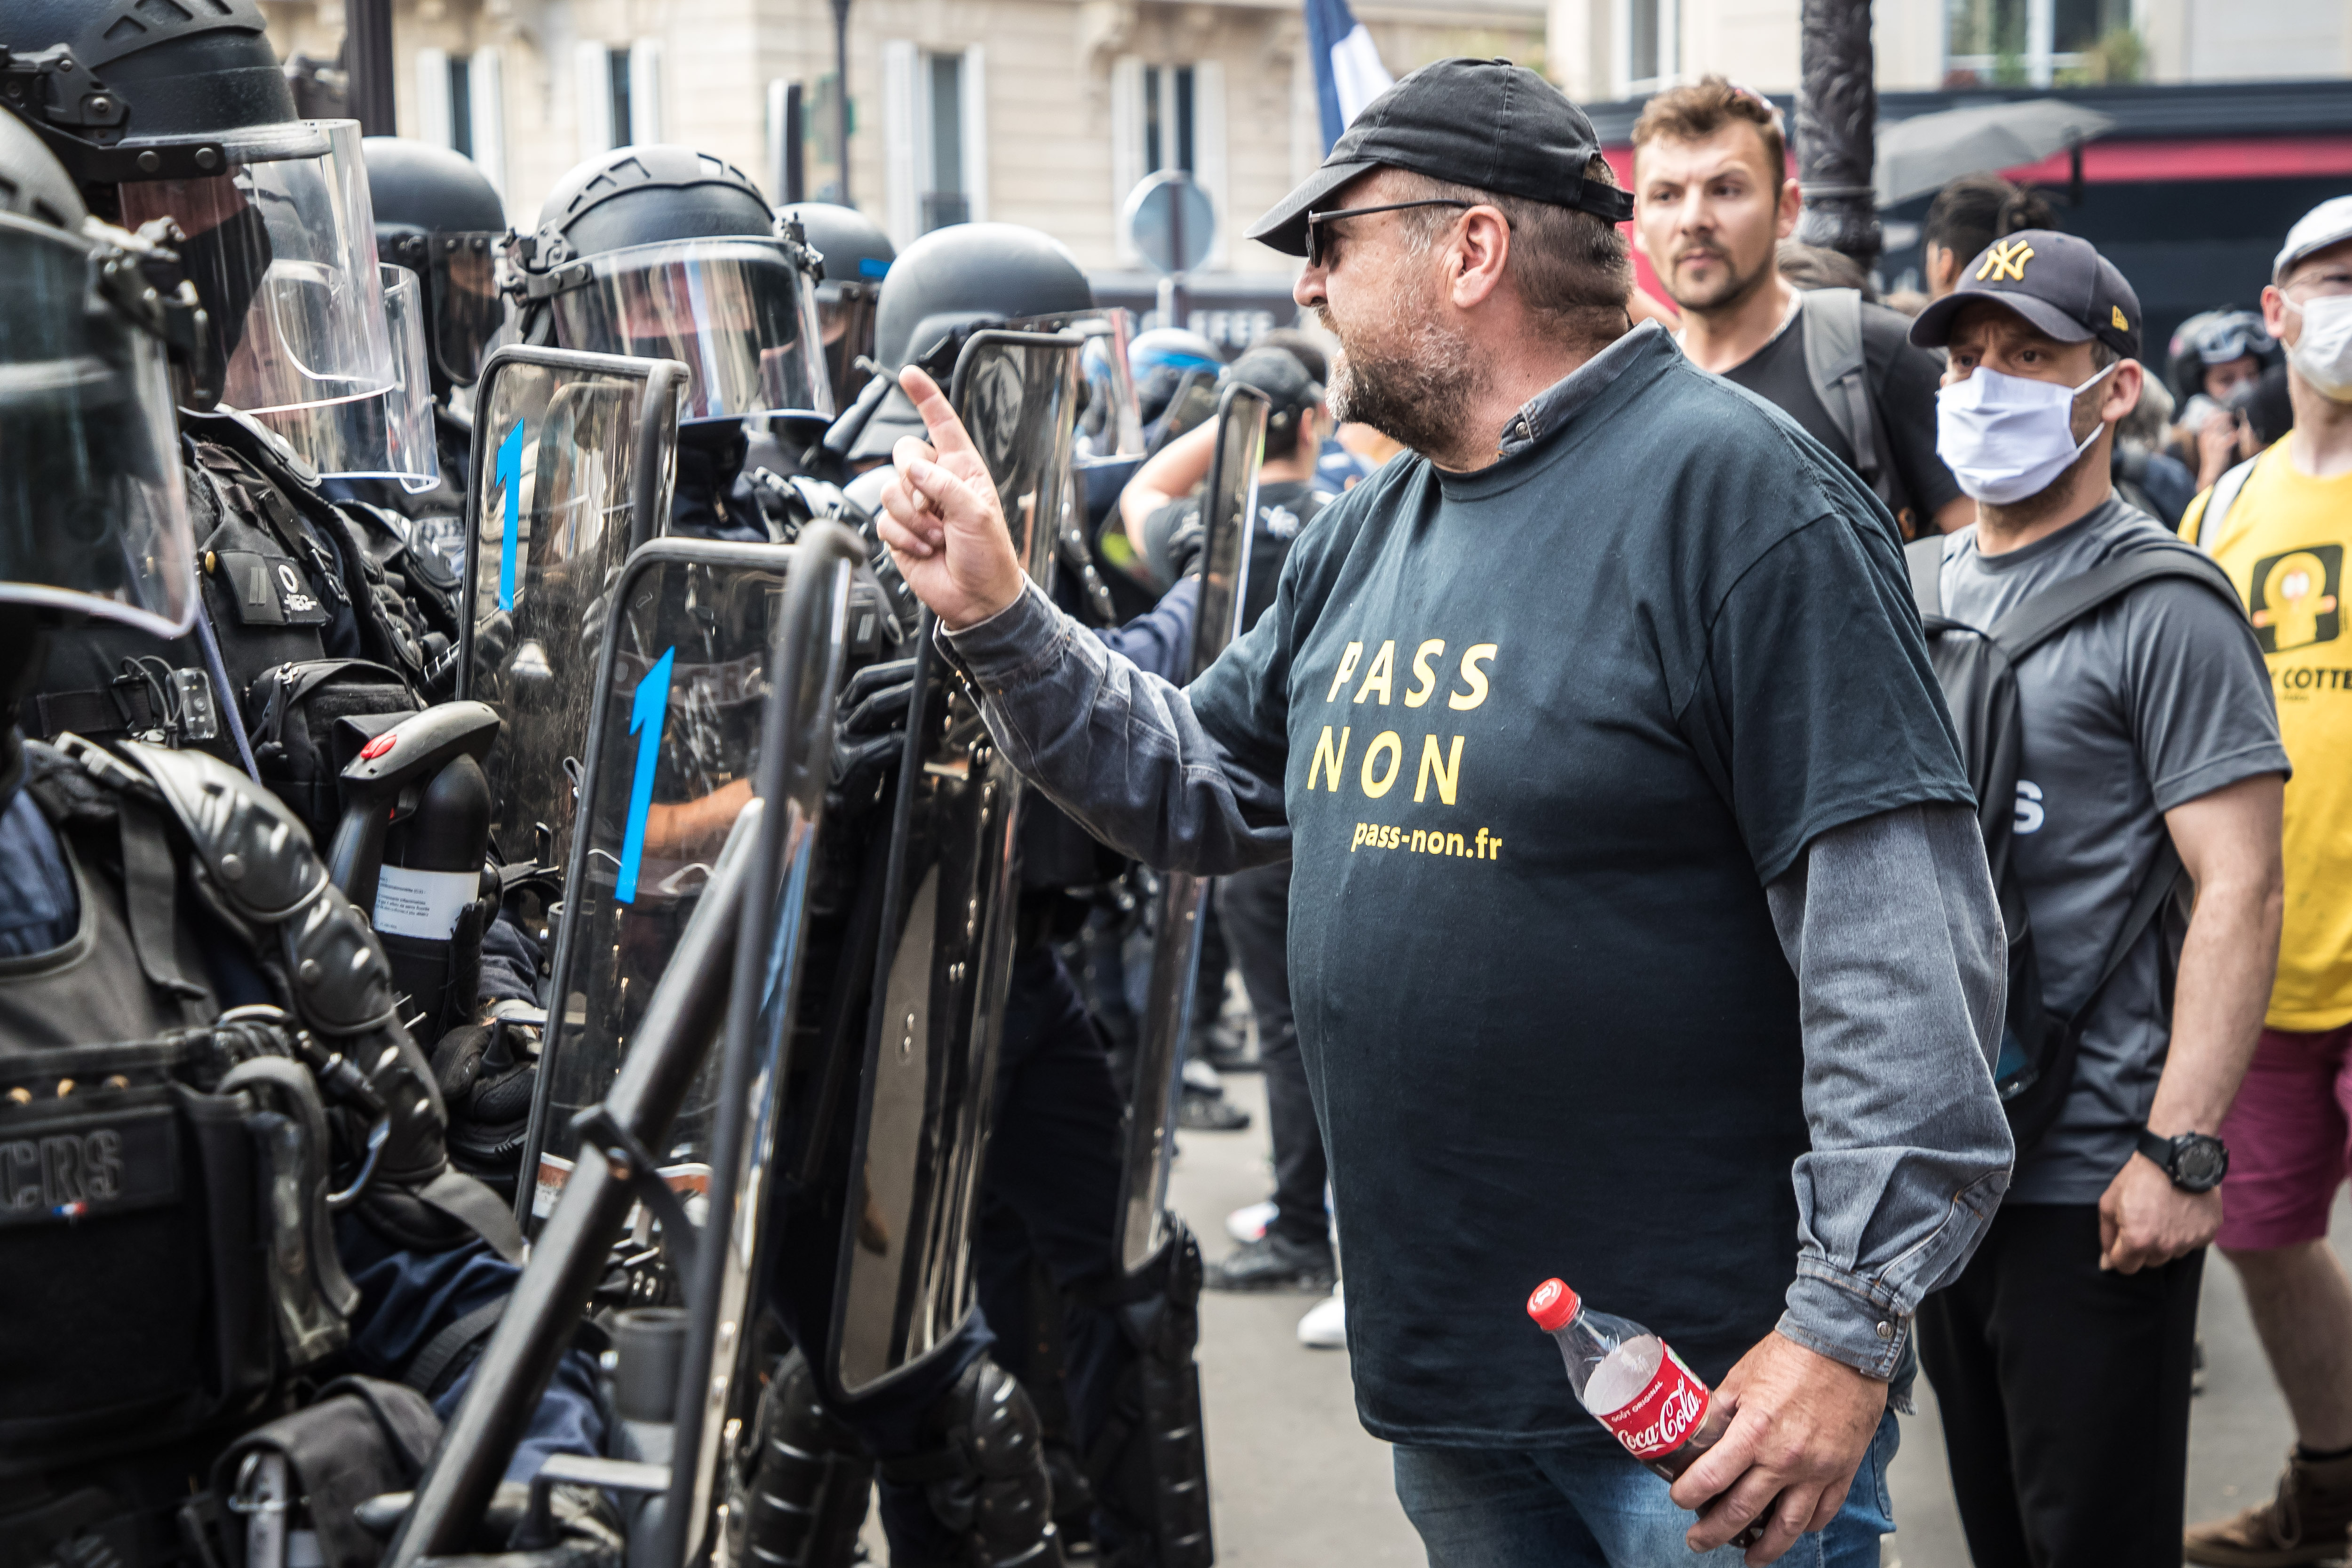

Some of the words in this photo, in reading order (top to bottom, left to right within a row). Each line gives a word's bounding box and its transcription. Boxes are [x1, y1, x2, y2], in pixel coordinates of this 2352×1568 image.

[1326, 638, 1498, 711] PASS
[1307, 725, 1465, 805] NON
[1351, 822, 1502, 860] pass-non.fr
[1617, 1372, 1700, 1455] Coca-Cola
[1632, 1380, 1663, 1413] ORIGINAL
